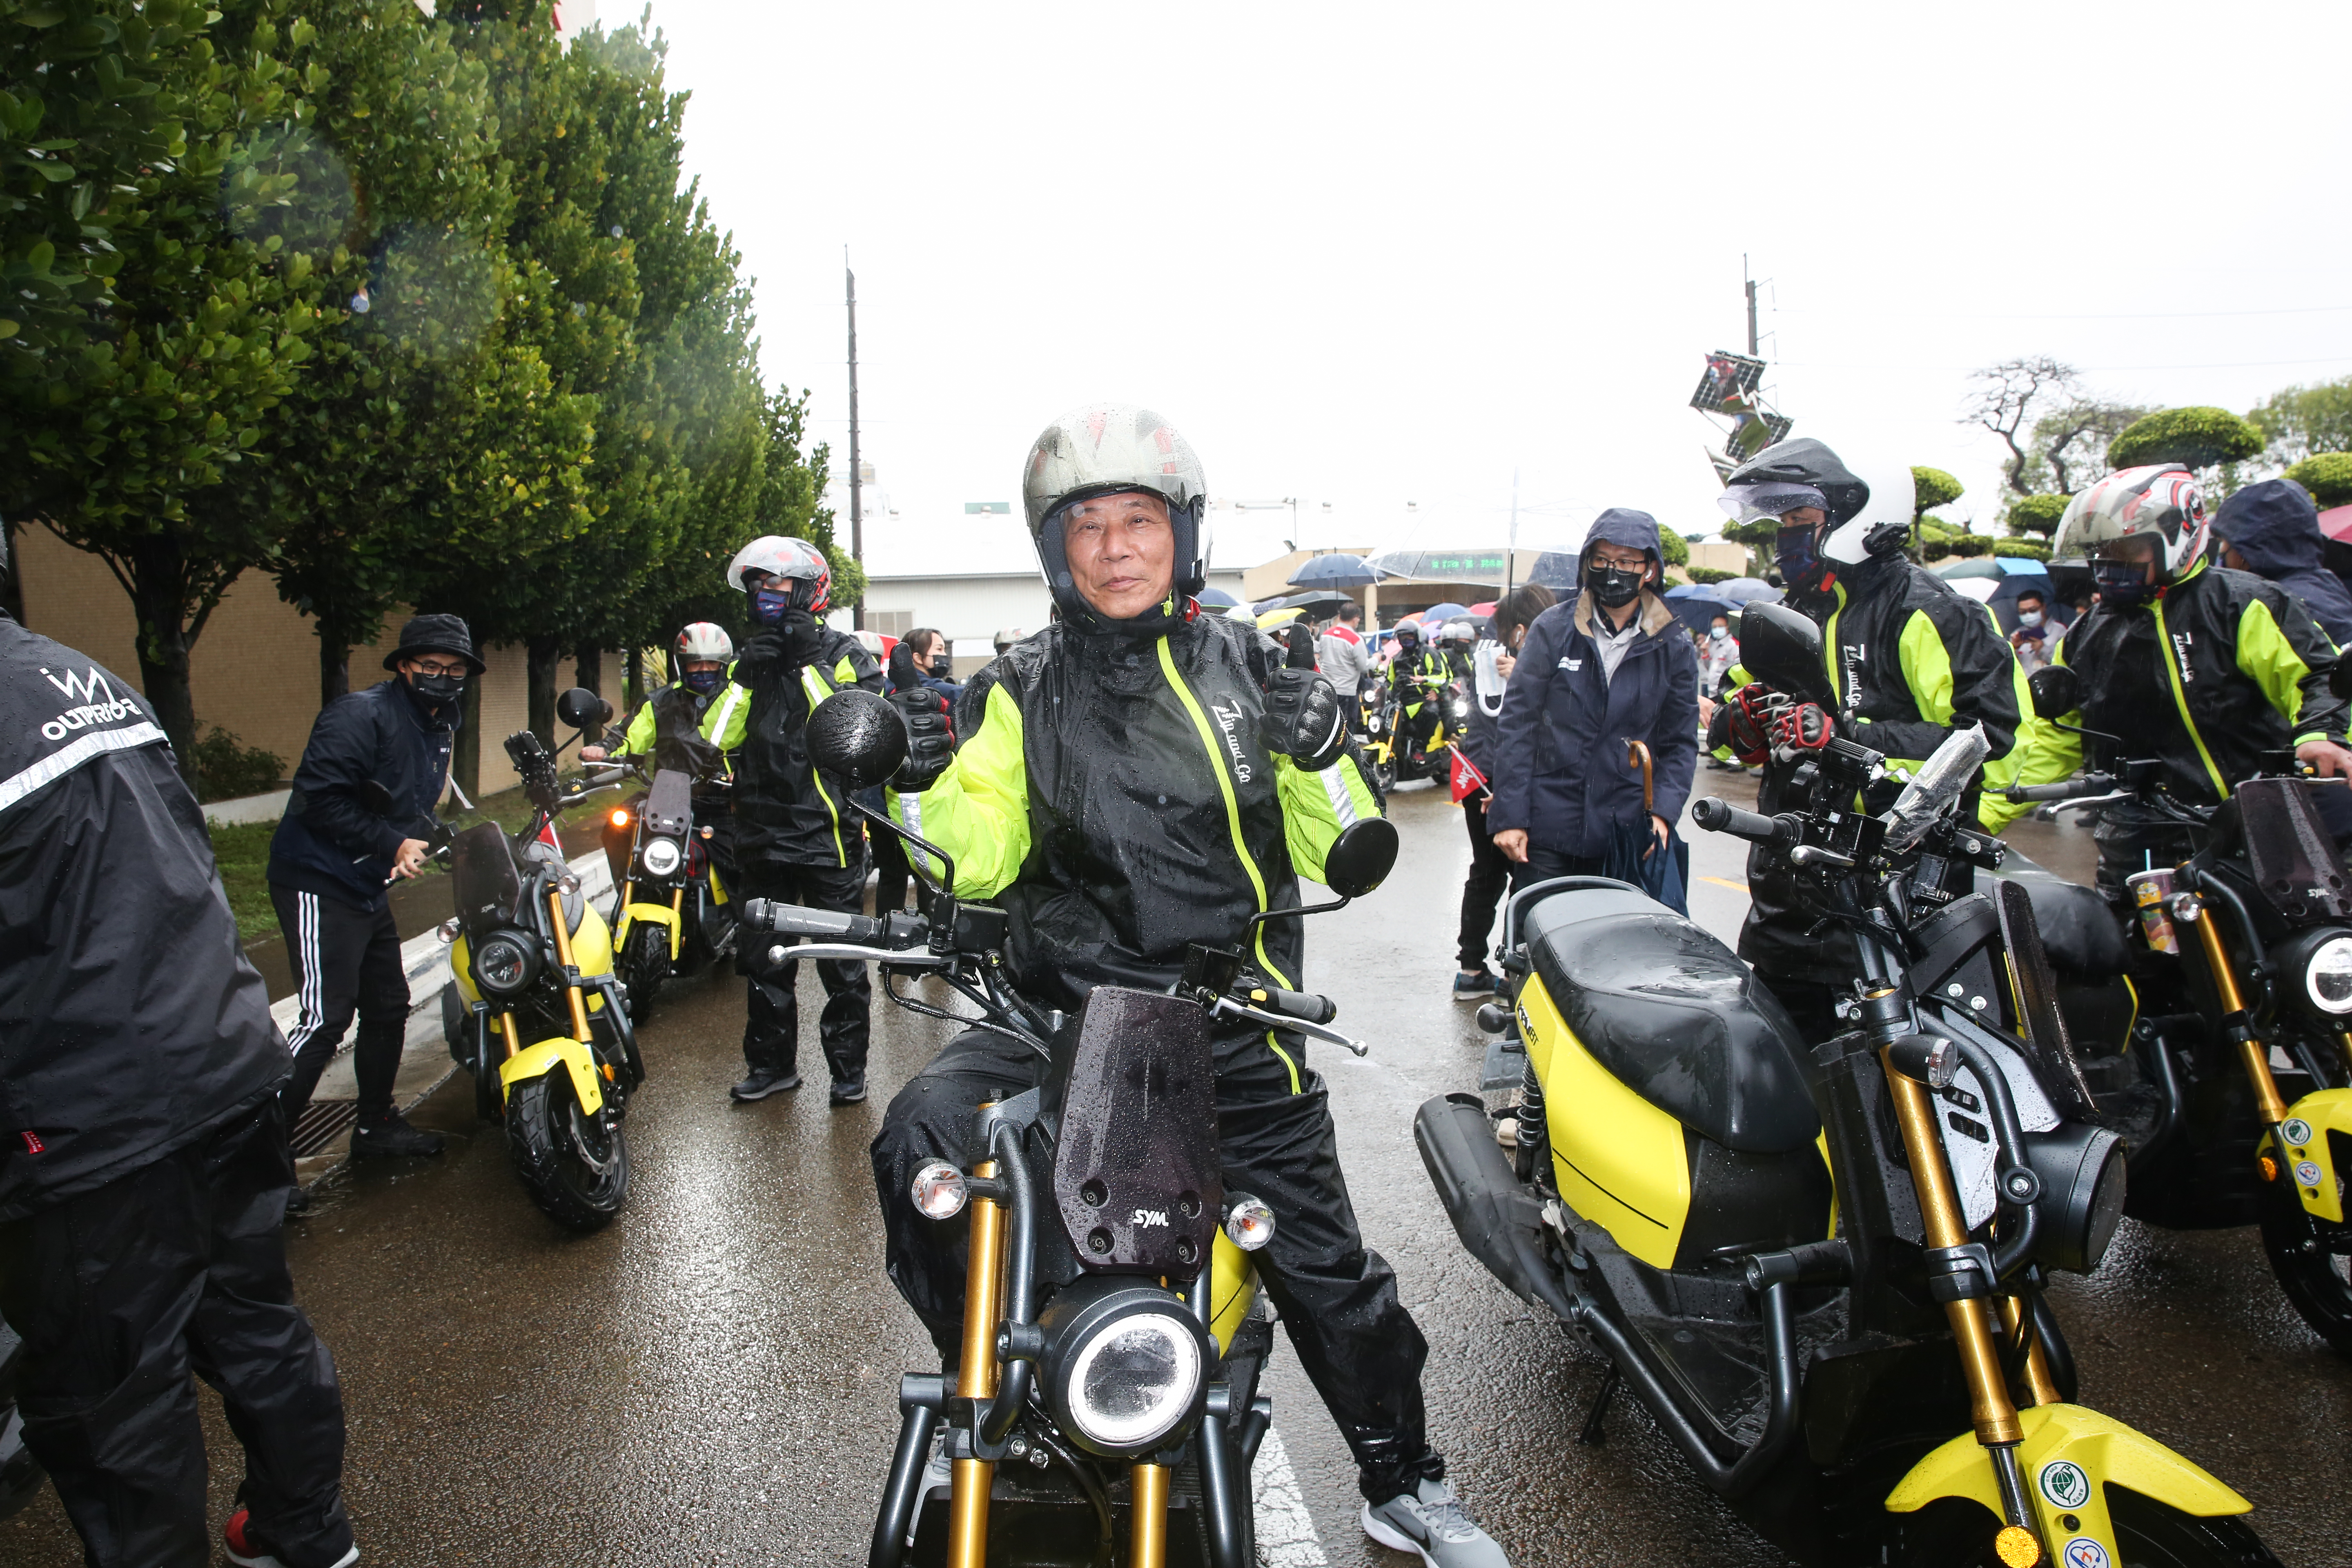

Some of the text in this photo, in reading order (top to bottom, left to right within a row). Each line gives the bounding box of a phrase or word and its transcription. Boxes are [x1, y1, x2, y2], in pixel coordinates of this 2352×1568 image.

[1843, 644, 1865, 668] Zip
[1211, 700, 1251, 784] Zip and Go
[2308, 889, 2330, 898] SYM
[1133, 1209, 1169, 1229] SYM
